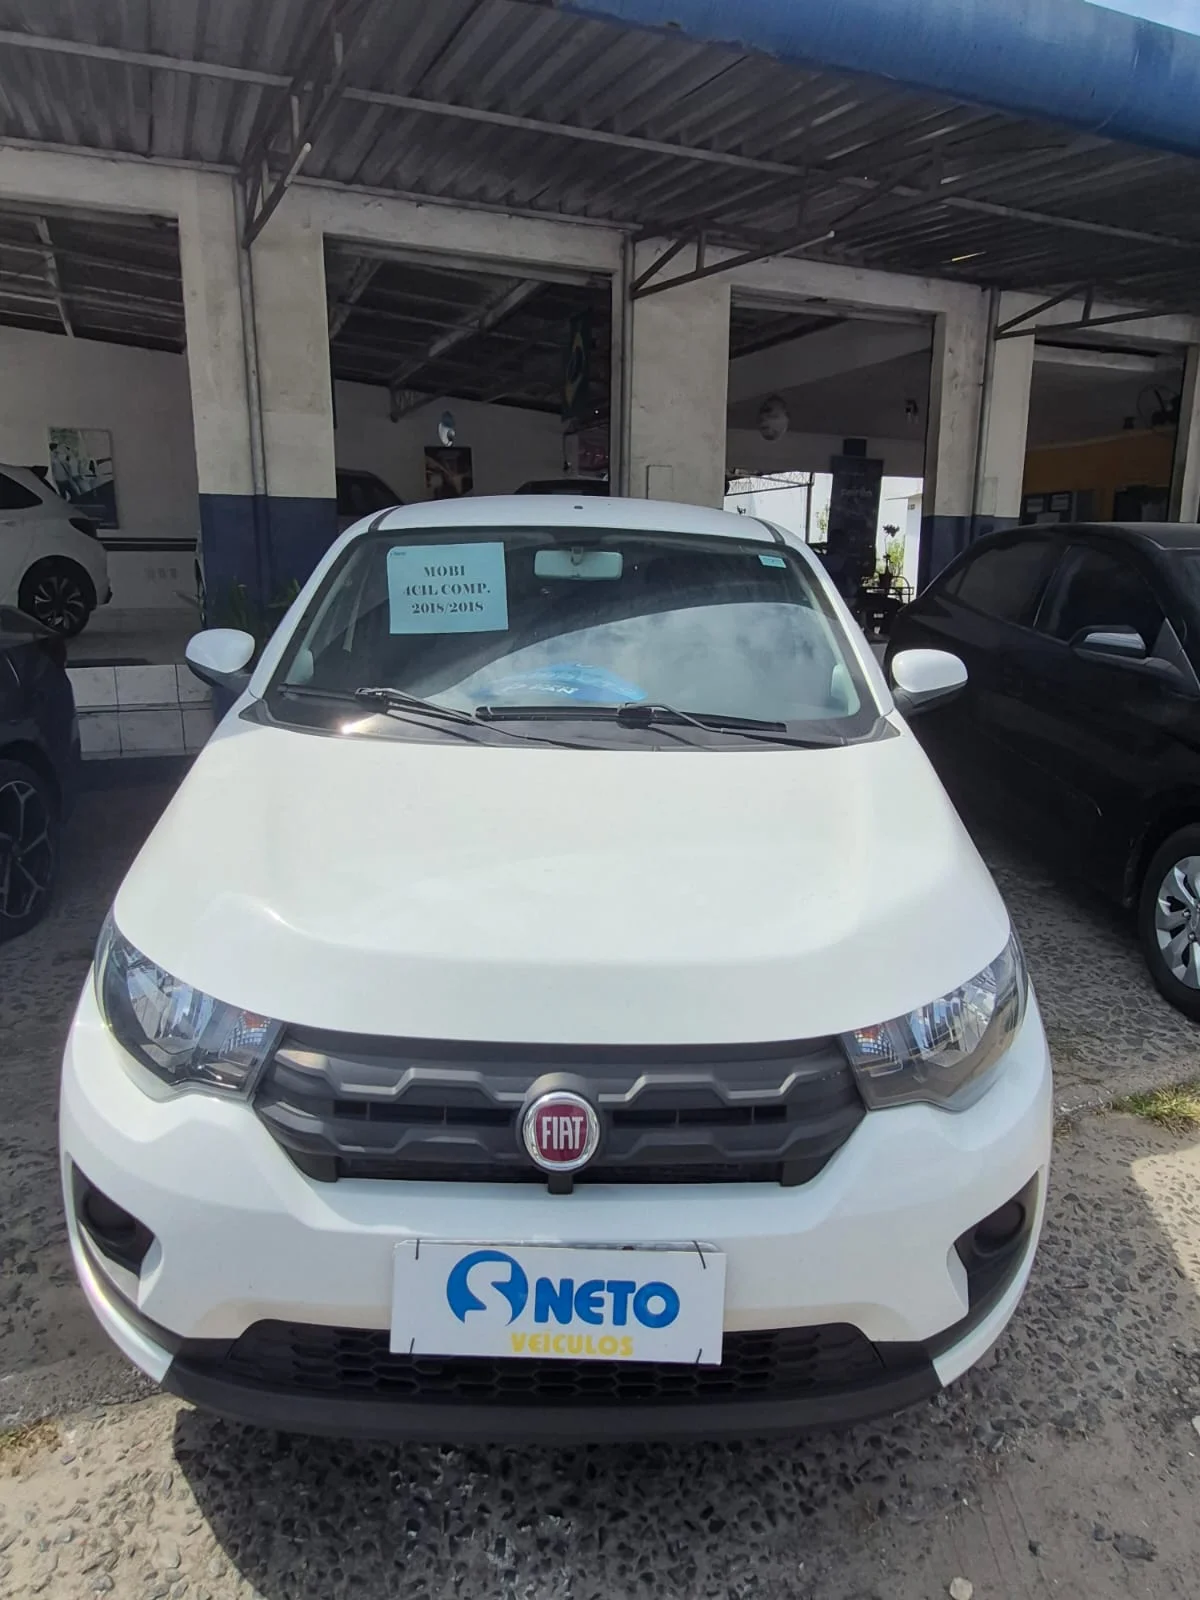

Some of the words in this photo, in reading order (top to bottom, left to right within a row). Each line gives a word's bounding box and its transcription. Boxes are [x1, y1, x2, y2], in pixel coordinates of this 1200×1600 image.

[423, 565, 466, 577] MOBI
[411, 601, 484, 614] 2018/2018
[541, 1116, 584, 1150] FIAT
[534, 1277, 680, 1328] NETO
